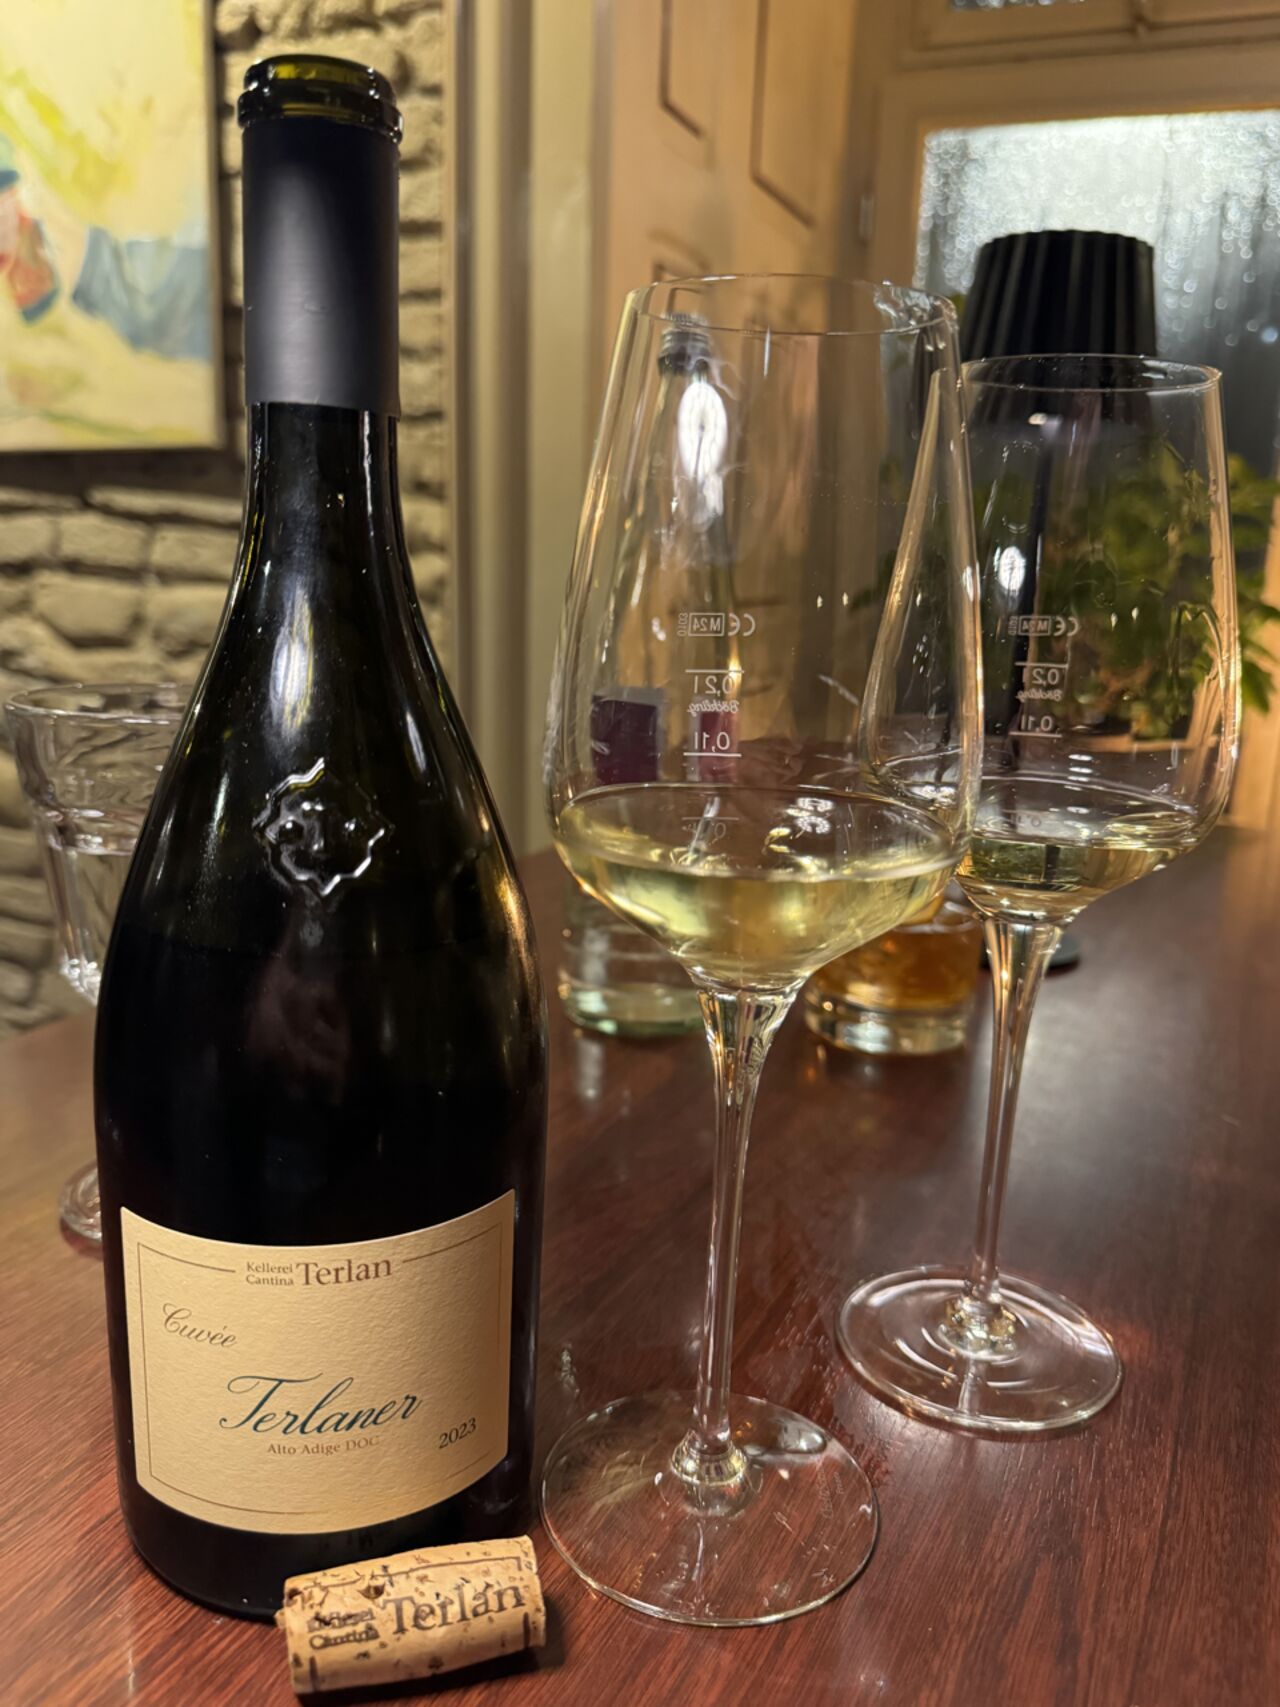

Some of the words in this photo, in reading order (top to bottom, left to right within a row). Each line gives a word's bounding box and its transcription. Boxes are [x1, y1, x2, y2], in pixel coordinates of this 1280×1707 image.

[245, 1274, 294, 1286] Cantina
[246, 1261, 293, 1274] Kellerei
[295, 1258, 392, 1286] Terlan
[162, 1303, 238, 1348] Cuvée
[219, 1373, 423, 1436] Terlaner
[438, 1417, 478, 1450] 2023
[266, 1443, 297, 1455] Alto
[301, 1443, 341, 1457] Adige
[382, 1583, 527, 1636] Terlan
